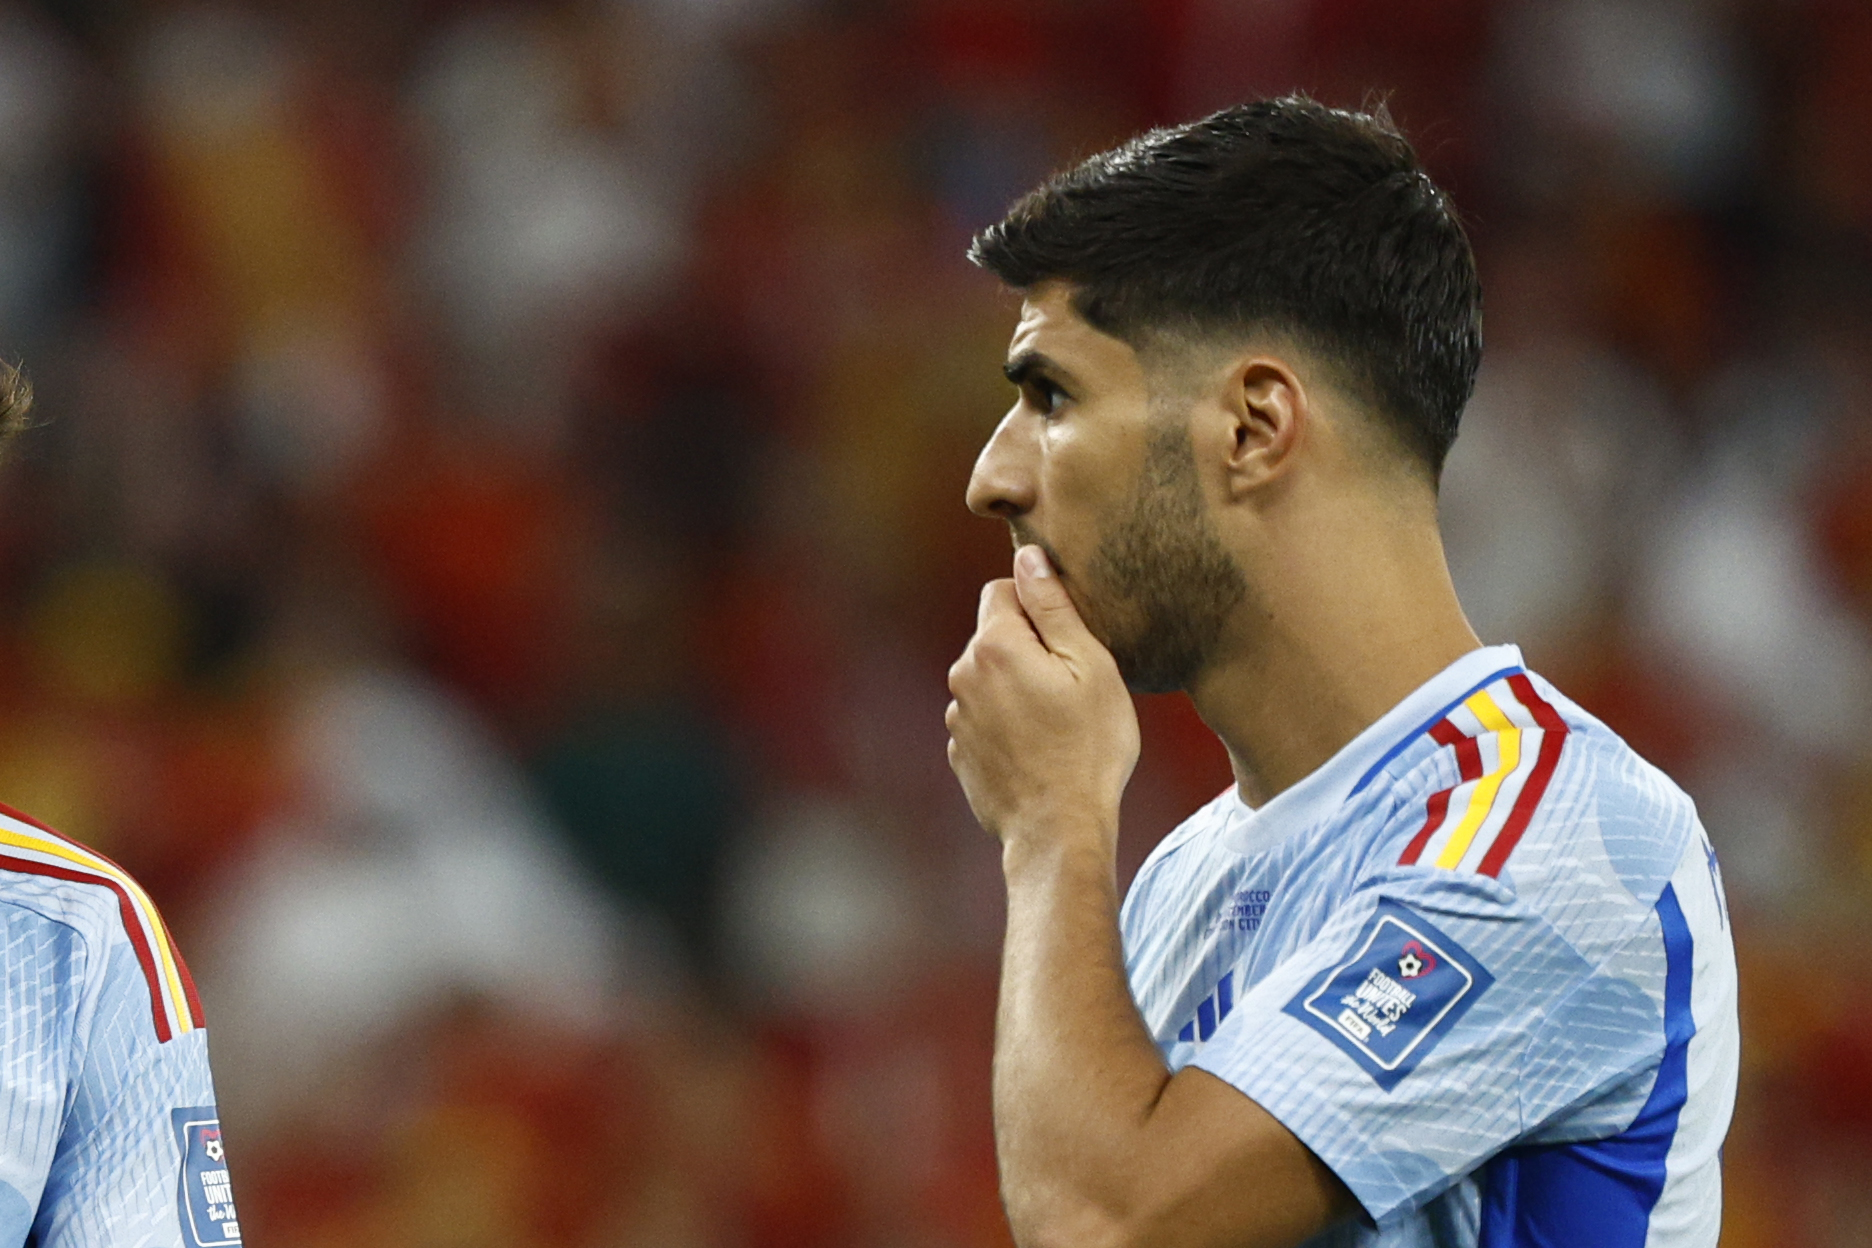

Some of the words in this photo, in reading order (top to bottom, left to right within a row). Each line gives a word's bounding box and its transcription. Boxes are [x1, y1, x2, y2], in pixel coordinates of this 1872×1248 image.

[1368, 967, 1417, 1009] FOOTBALL
[1355, 979, 1408, 1022] UNITES
[200, 1169, 231, 1186] FOOTB
[203, 1183, 234, 1205] UNIT
[206, 1204, 226, 1222] the
